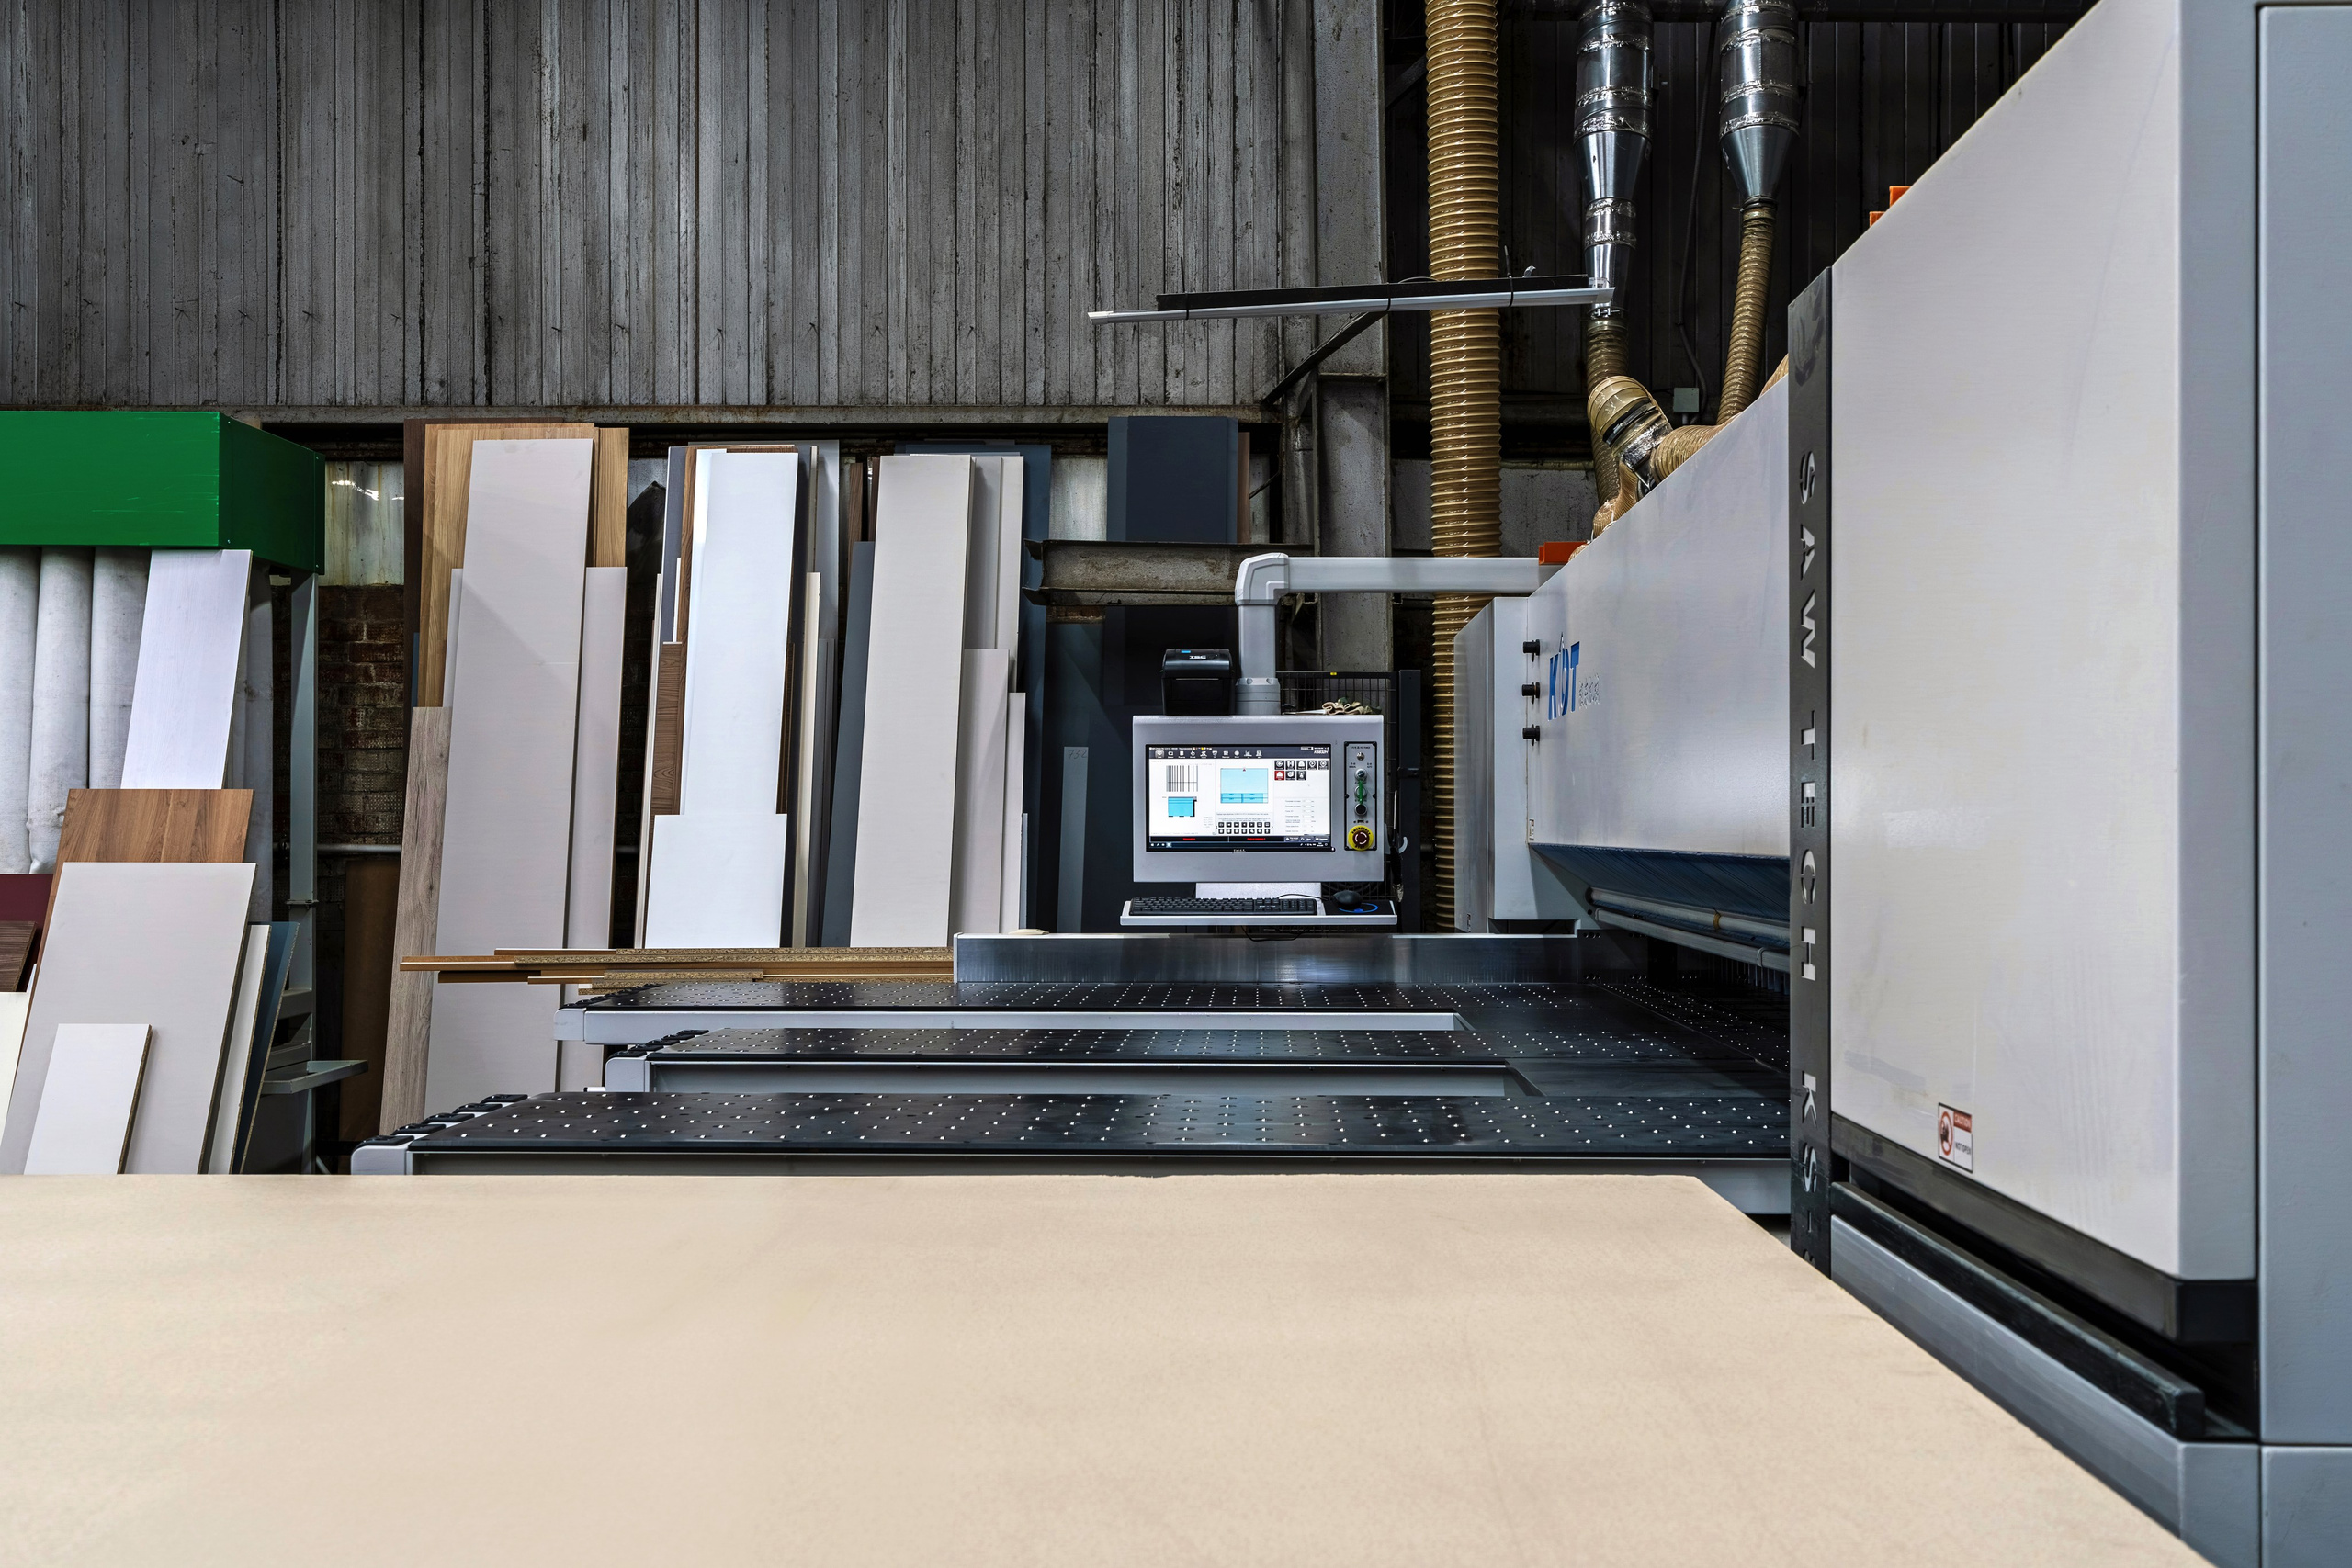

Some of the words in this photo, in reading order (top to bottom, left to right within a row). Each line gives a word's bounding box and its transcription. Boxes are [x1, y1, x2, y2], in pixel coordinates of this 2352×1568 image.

[1798, 451, 1816, 670] SAW
[1351, 827, 1371, 835] EMERGENCY
[1799, 710, 1817, 982] TECH
[1799, 1070, 1817, 1268] KS-
[1954, 1112, 1971, 1129] CAUTION
